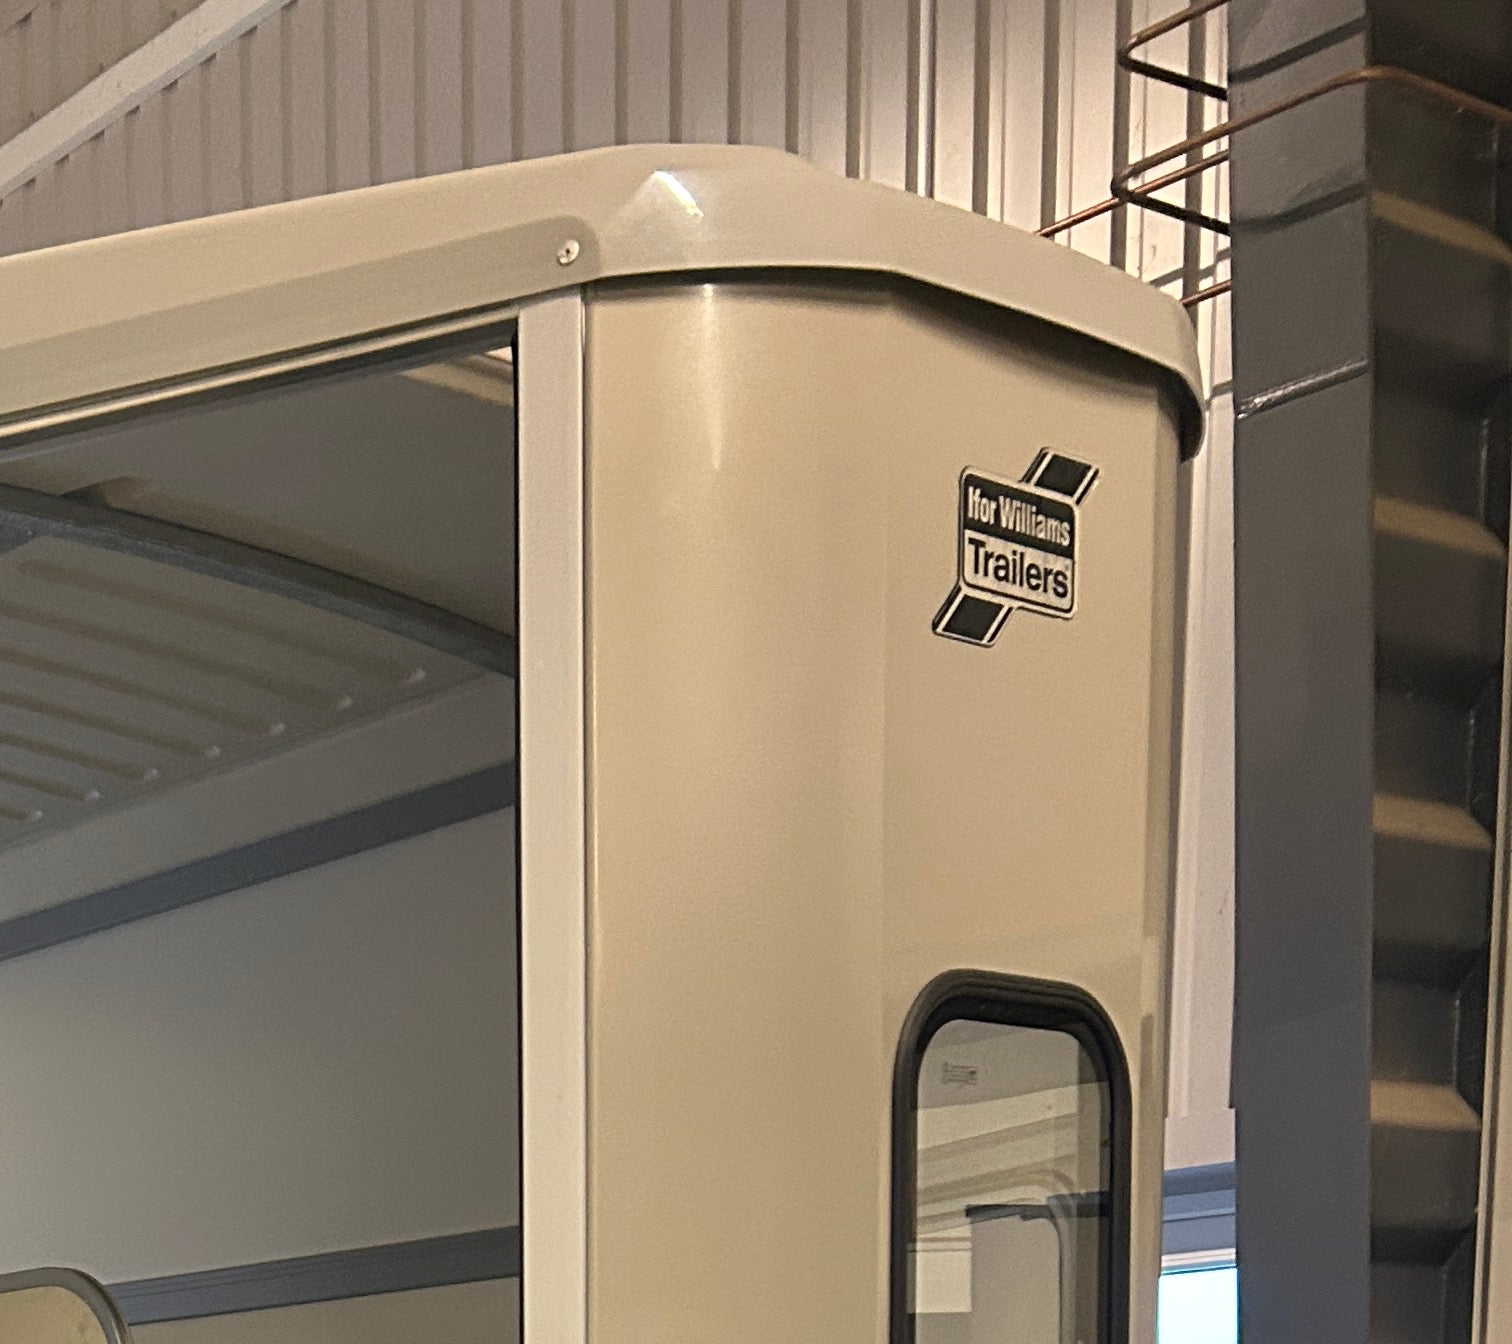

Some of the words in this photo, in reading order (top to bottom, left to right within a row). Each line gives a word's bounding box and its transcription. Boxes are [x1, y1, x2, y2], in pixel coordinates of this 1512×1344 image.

[967, 486, 997, 524] Ifor
[998, 495, 1070, 547] Williams
[968, 537, 1069, 599] Trailers
